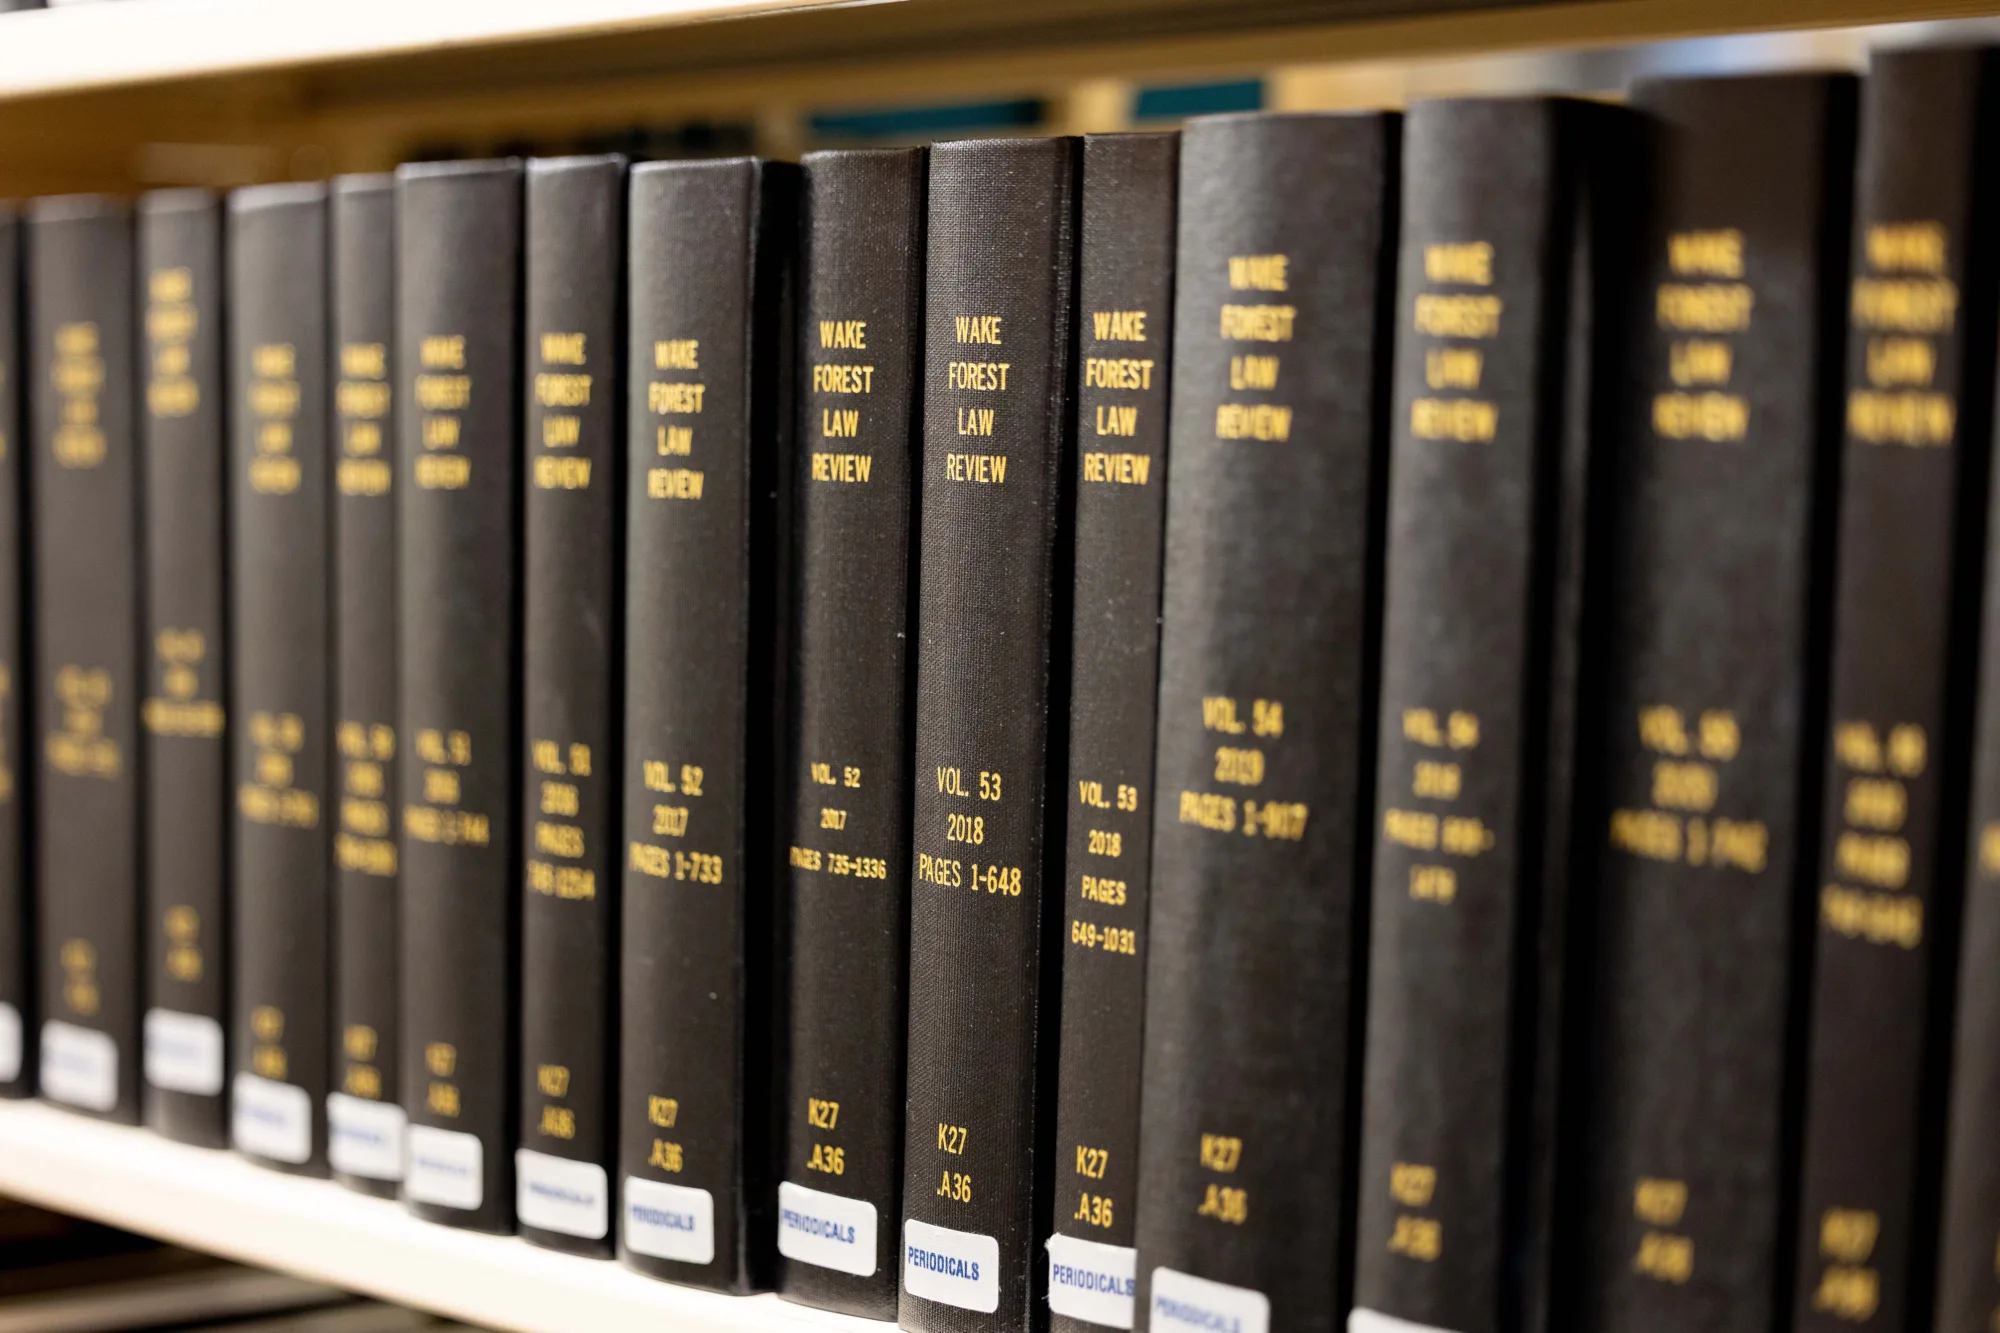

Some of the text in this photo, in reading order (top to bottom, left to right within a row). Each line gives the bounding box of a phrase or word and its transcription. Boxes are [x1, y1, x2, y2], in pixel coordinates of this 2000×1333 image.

[819, 320, 867, 350] WAKE
[955, 315, 1002, 345] WAKE
[1093, 310, 1147, 342] WAKE
[1220, 304, 1297, 342] FOREST
[654, 338, 699, 370] WAKE
[813, 364, 875, 394] FOREST
[948, 362, 1010, 391] FOREST
[1085, 358, 1155, 390] FOREST
[1230, 355, 1280, 390] LAW
[648, 382, 705, 413] FOREST
[822, 409, 859, 438] LAW
[957, 408, 996, 436] LAW
[1096, 405, 1138, 437] LAW
[1215, 403, 1293, 442] REVIEW
[657, 425, 693, 456] LAW
[647, 468, 704, 499] REVIEW
[811, 453, 872, 483] REVIEW
[946, 453, 1007, 484] REVIEW
[1083, 452, 1152, 485] REVIEW
[811, 762, 861, 789] VOL. 52
[937, 766, 1002, 801] VOL. 53
[1079, 780, 1138, 812] VOL. 53
[820, 807, 847, 831] 2017
[946, 813, 985, 845] 2018
[1087, 829, 1122, 858] 2018
[827, 852, 887, 880] 735-1336
[918, 852, 1022, 897] PAGES 1-648
[1081, 875, 1127, 906] PAGES
[1071, 919, 1137, 956] 649-1031
[807, 1096, 840, 1130] K27
[937, 1123, 968, 1155] K27
[807, 1143, 846, 1177] .A36
[1075, 1144, 1109, 1180] K27
[936, 1170, 972, 1203] .A36
[1073, 1191, 1114, 1229] .A36
[781, 1207, 856, 1246] PERIODICALS
[907, 1244, 980, 1282] PERIODICALS
[1052, 1263, 1134, 1298] PERIODICALS
